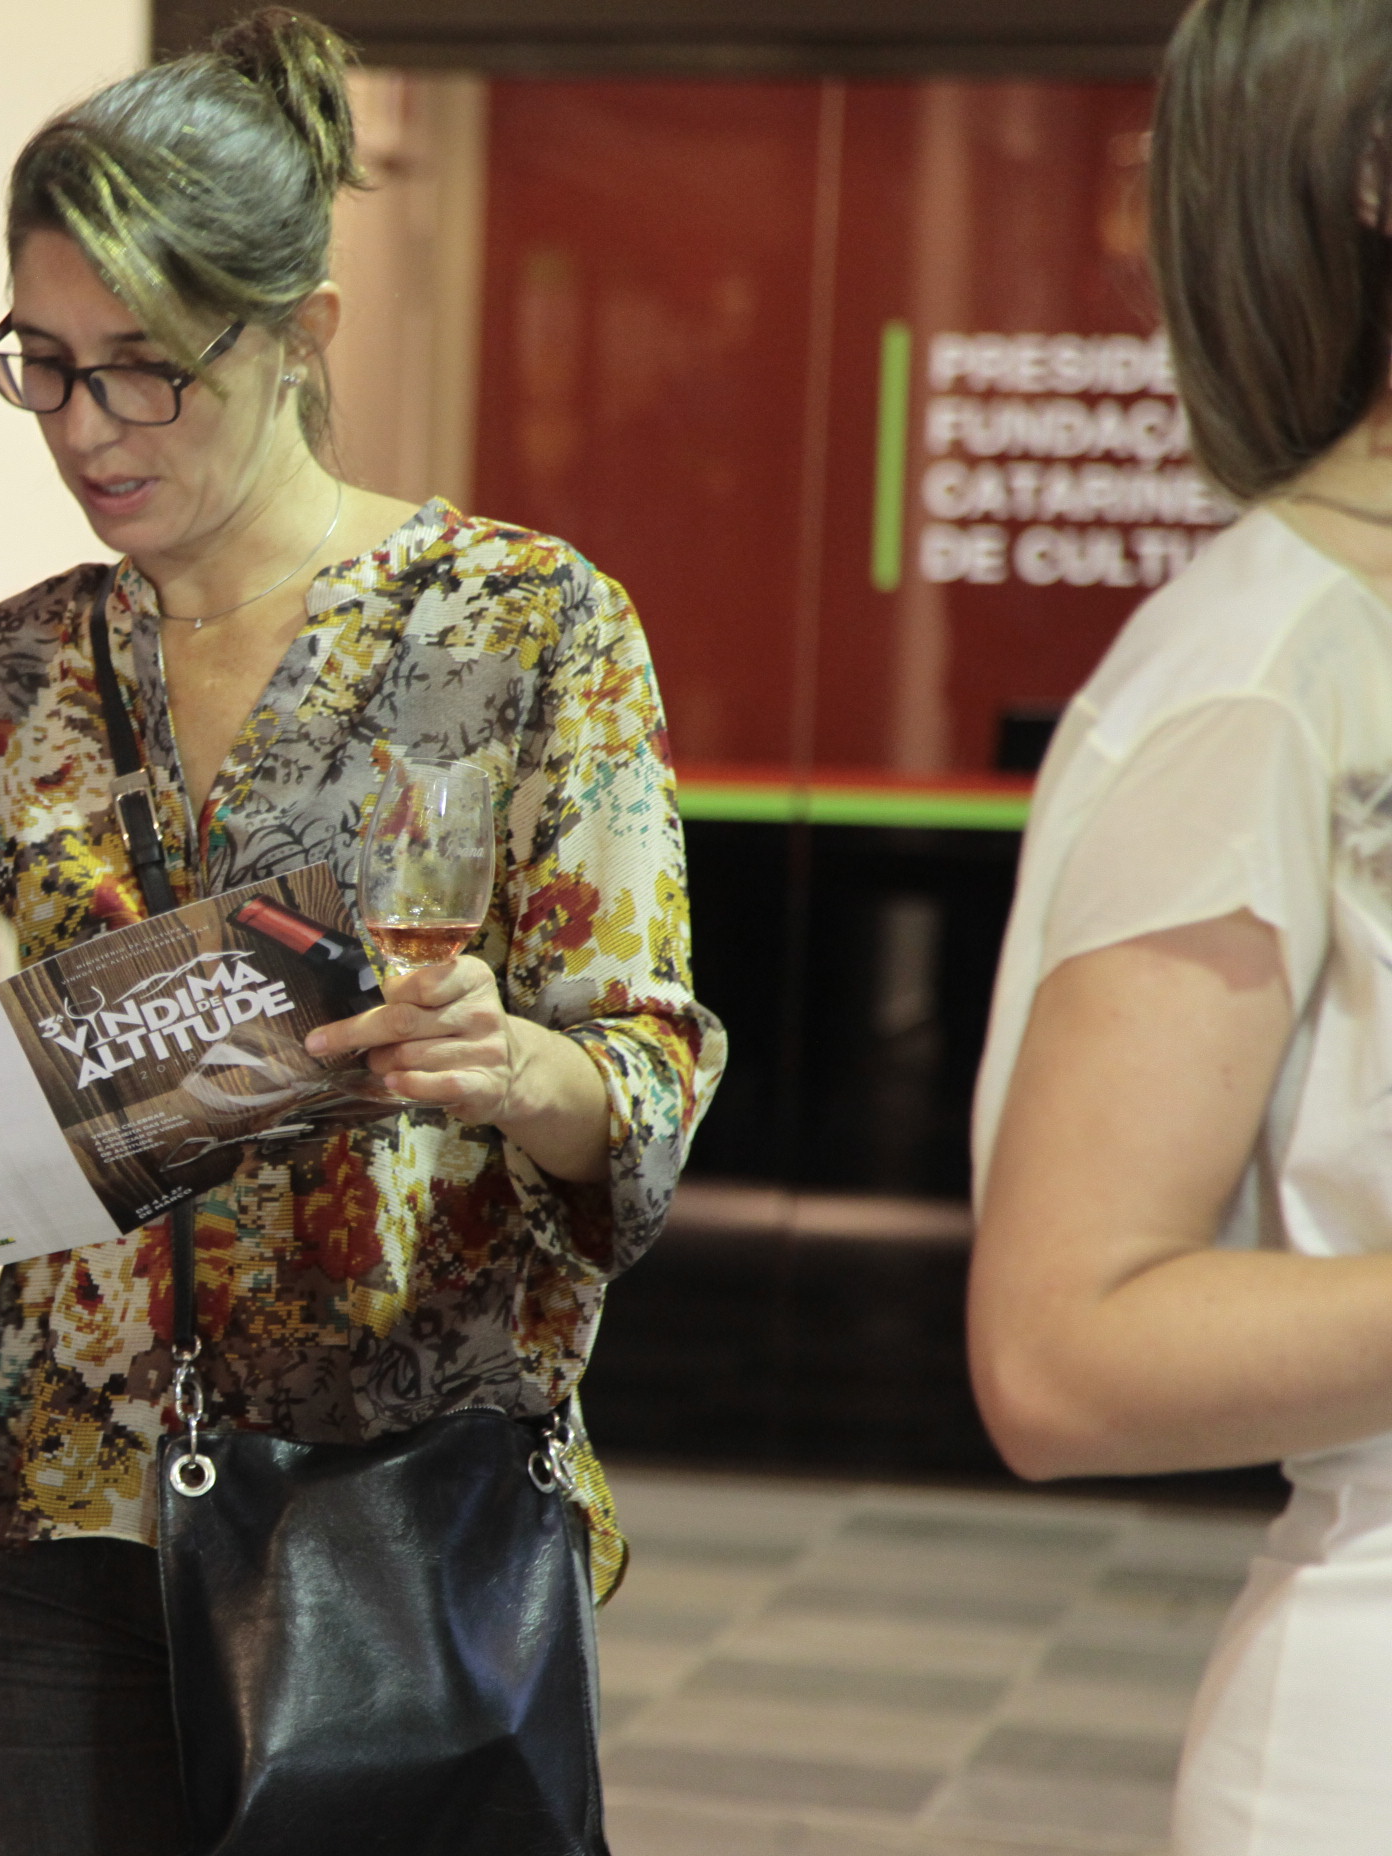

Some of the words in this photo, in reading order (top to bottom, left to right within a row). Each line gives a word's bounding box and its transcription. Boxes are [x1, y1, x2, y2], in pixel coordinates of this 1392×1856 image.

[918, 524, 1008, 584] DE
[197, 996, 224, 1013] DE
[78, 980, 296, 1090] ALTITUDE
[91, 1127, 121, 1139] VENHA
[121, 1112, 165, 1130] CELEBRAR
[102, 1128, 141, 1143] COLHEITA
[143, 1121, 159, 1130] DAS
[160, 1114, 183, 1125] UVAS
[114, 1138, 153, 1154] ALTITUDE
[136, 1204, 151, 1214] DE
[138, 1209, 153, 1219] DE
